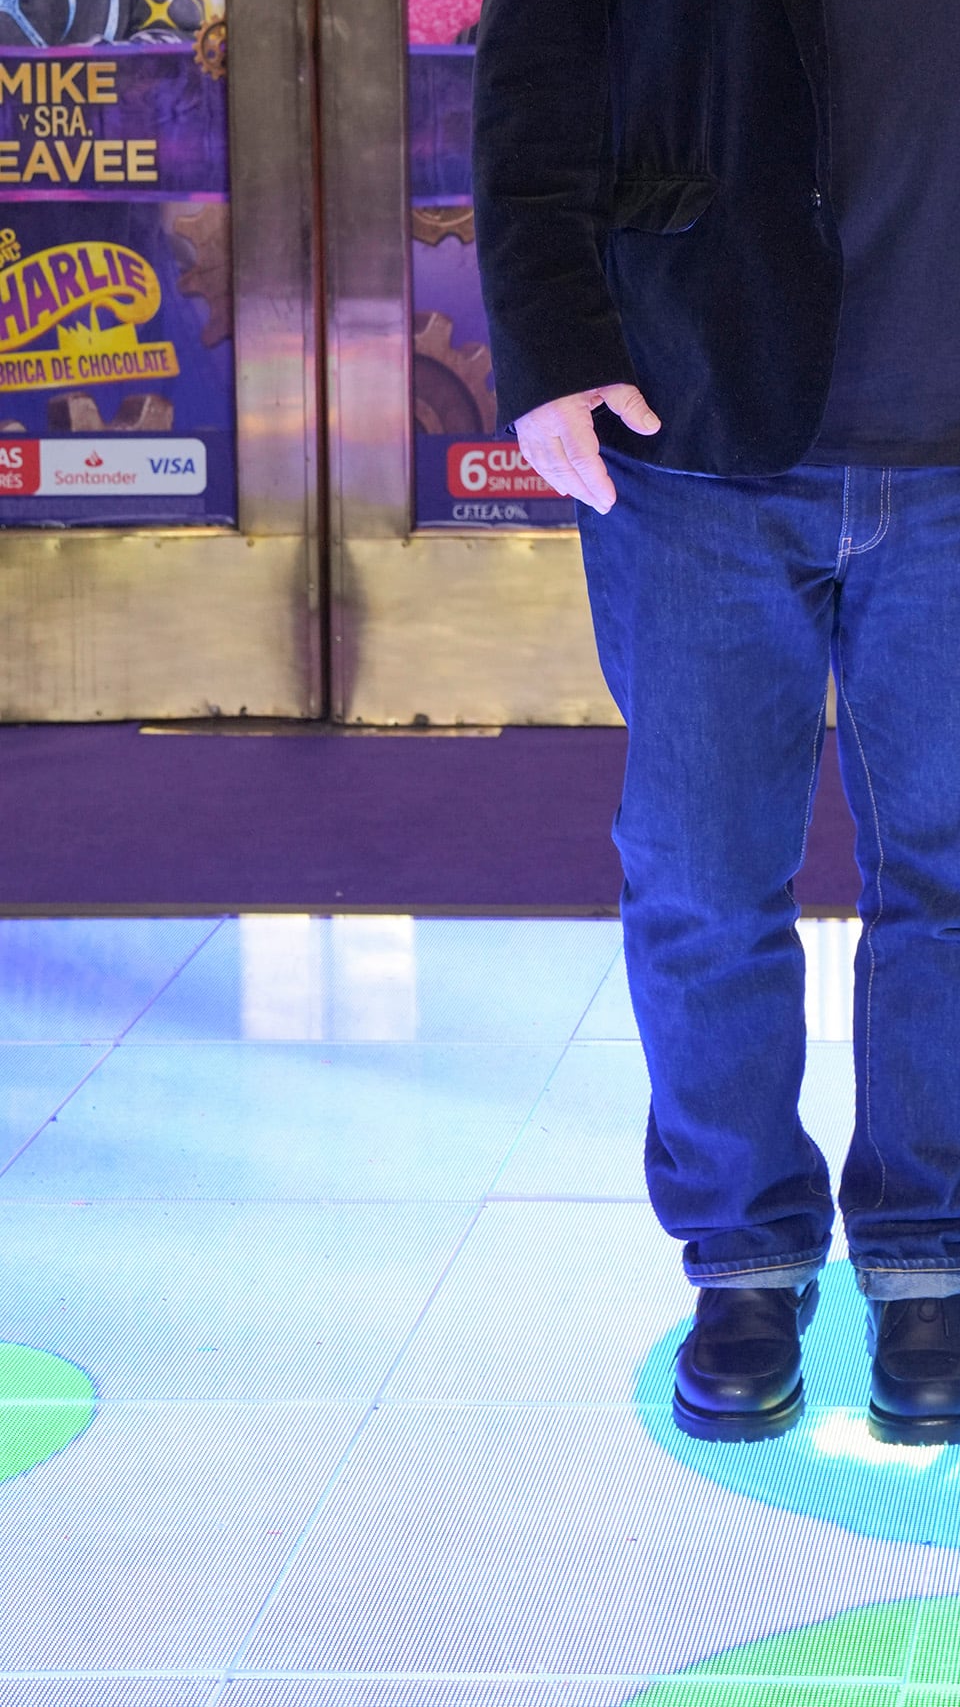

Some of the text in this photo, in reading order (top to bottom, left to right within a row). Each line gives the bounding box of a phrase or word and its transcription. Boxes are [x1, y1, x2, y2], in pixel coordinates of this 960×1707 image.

[0, 62, 118, 104] MIKE
[19, 106, 93, 137] Y SRA.
[51, 356, 74, 381] DE
[78, 348, 170, 379] CHOCOLATE
[55, 470, 137, 486] Santander
[147, 458, 196, 475] VISA
[460, 450, 488, 491] 6
[488, 477, 511, 491] SIN
